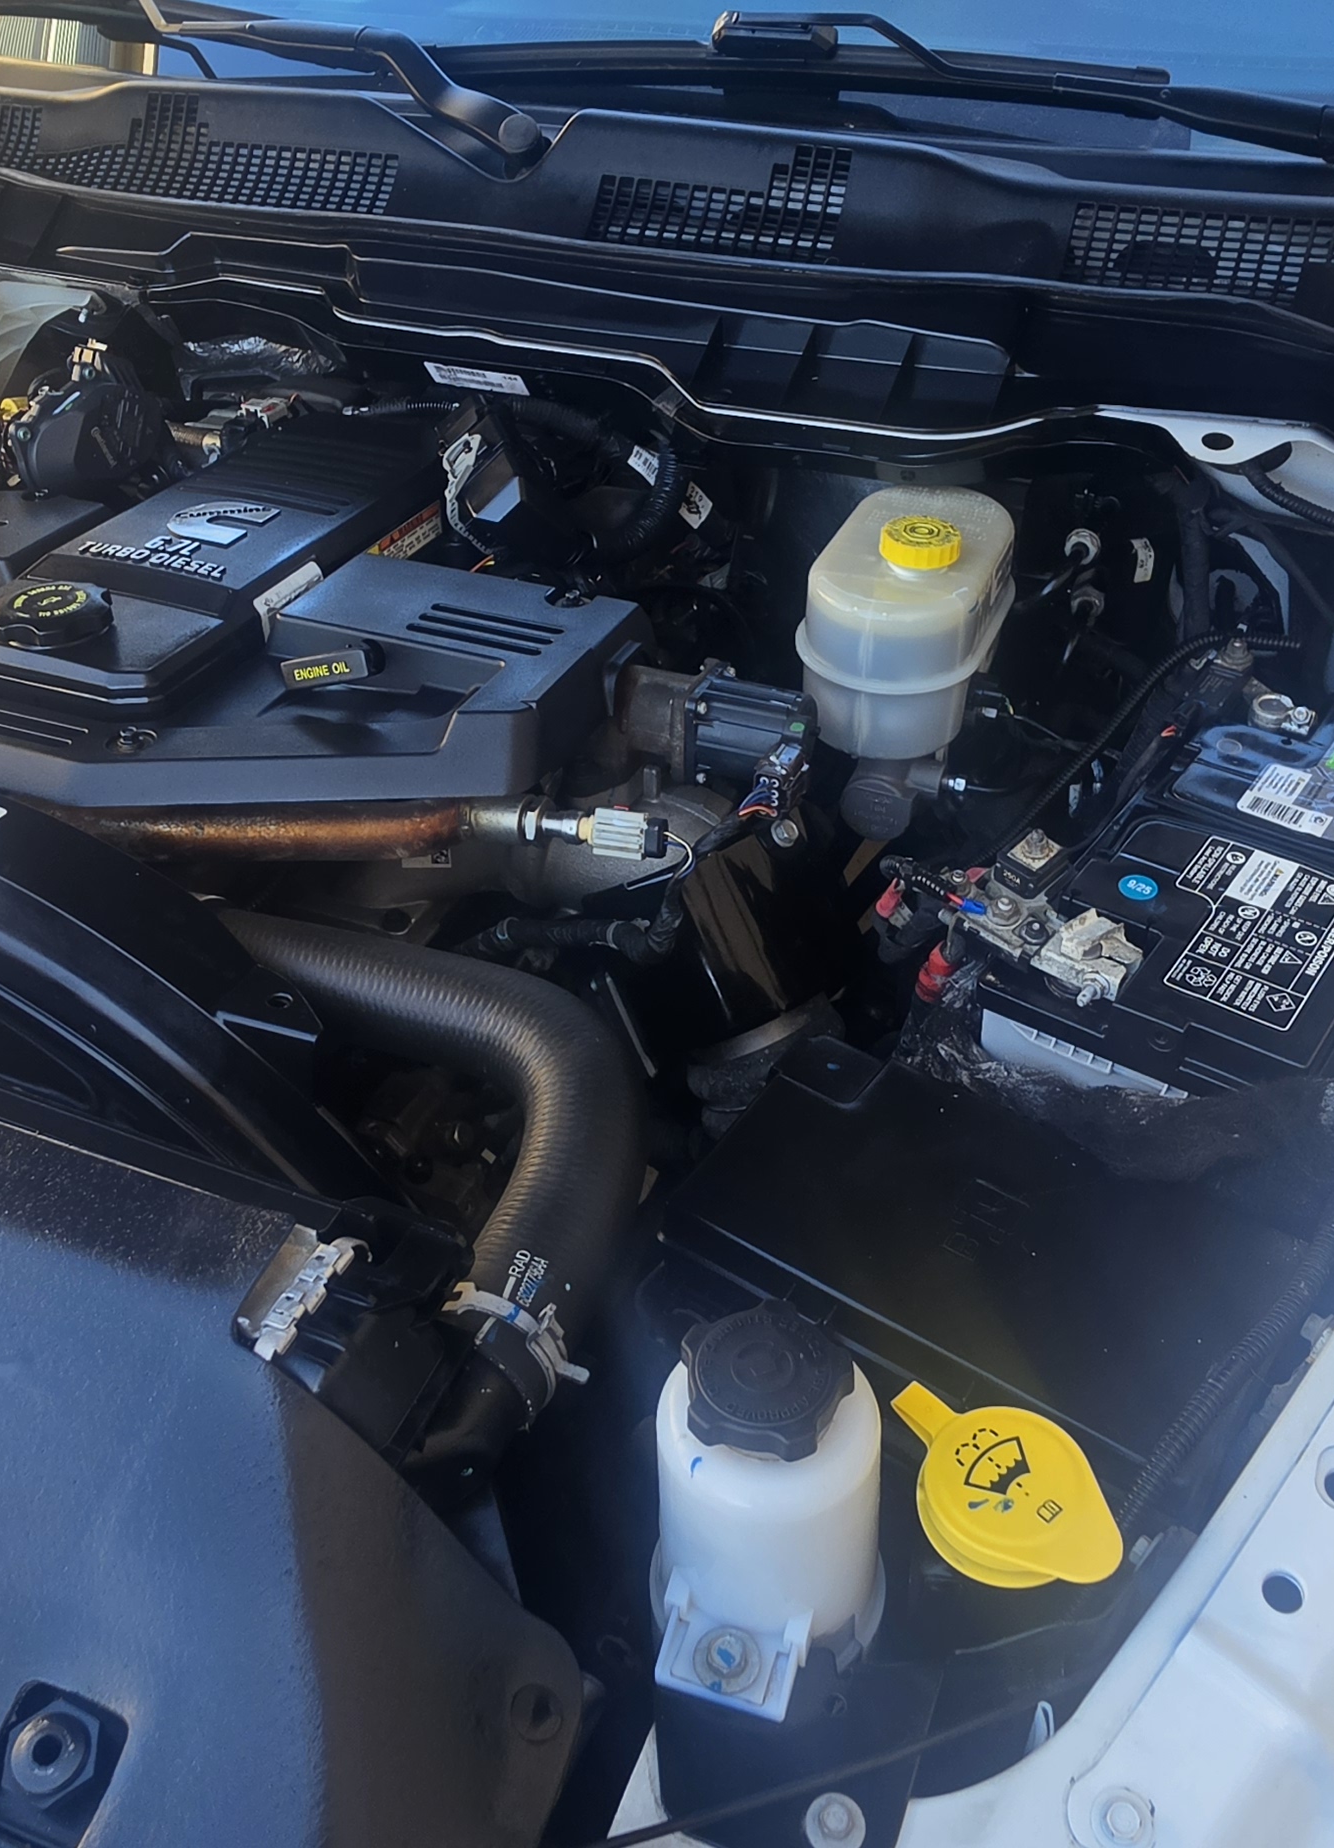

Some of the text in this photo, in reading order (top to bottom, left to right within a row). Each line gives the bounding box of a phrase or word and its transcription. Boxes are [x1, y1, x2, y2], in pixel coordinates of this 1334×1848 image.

[144, 535, 201, 557] 6.7L
[77, 540, 228, 581] TURBO DIESEL
[293, 661, 350, 681] ENGINE OIL
[1126, 879, 1153, 896] 9/25
[1206, 941, 1222, 956] NOT
[1216, 945, 1230, 958] DO
[508, 1249, 532, 1278] RAD
